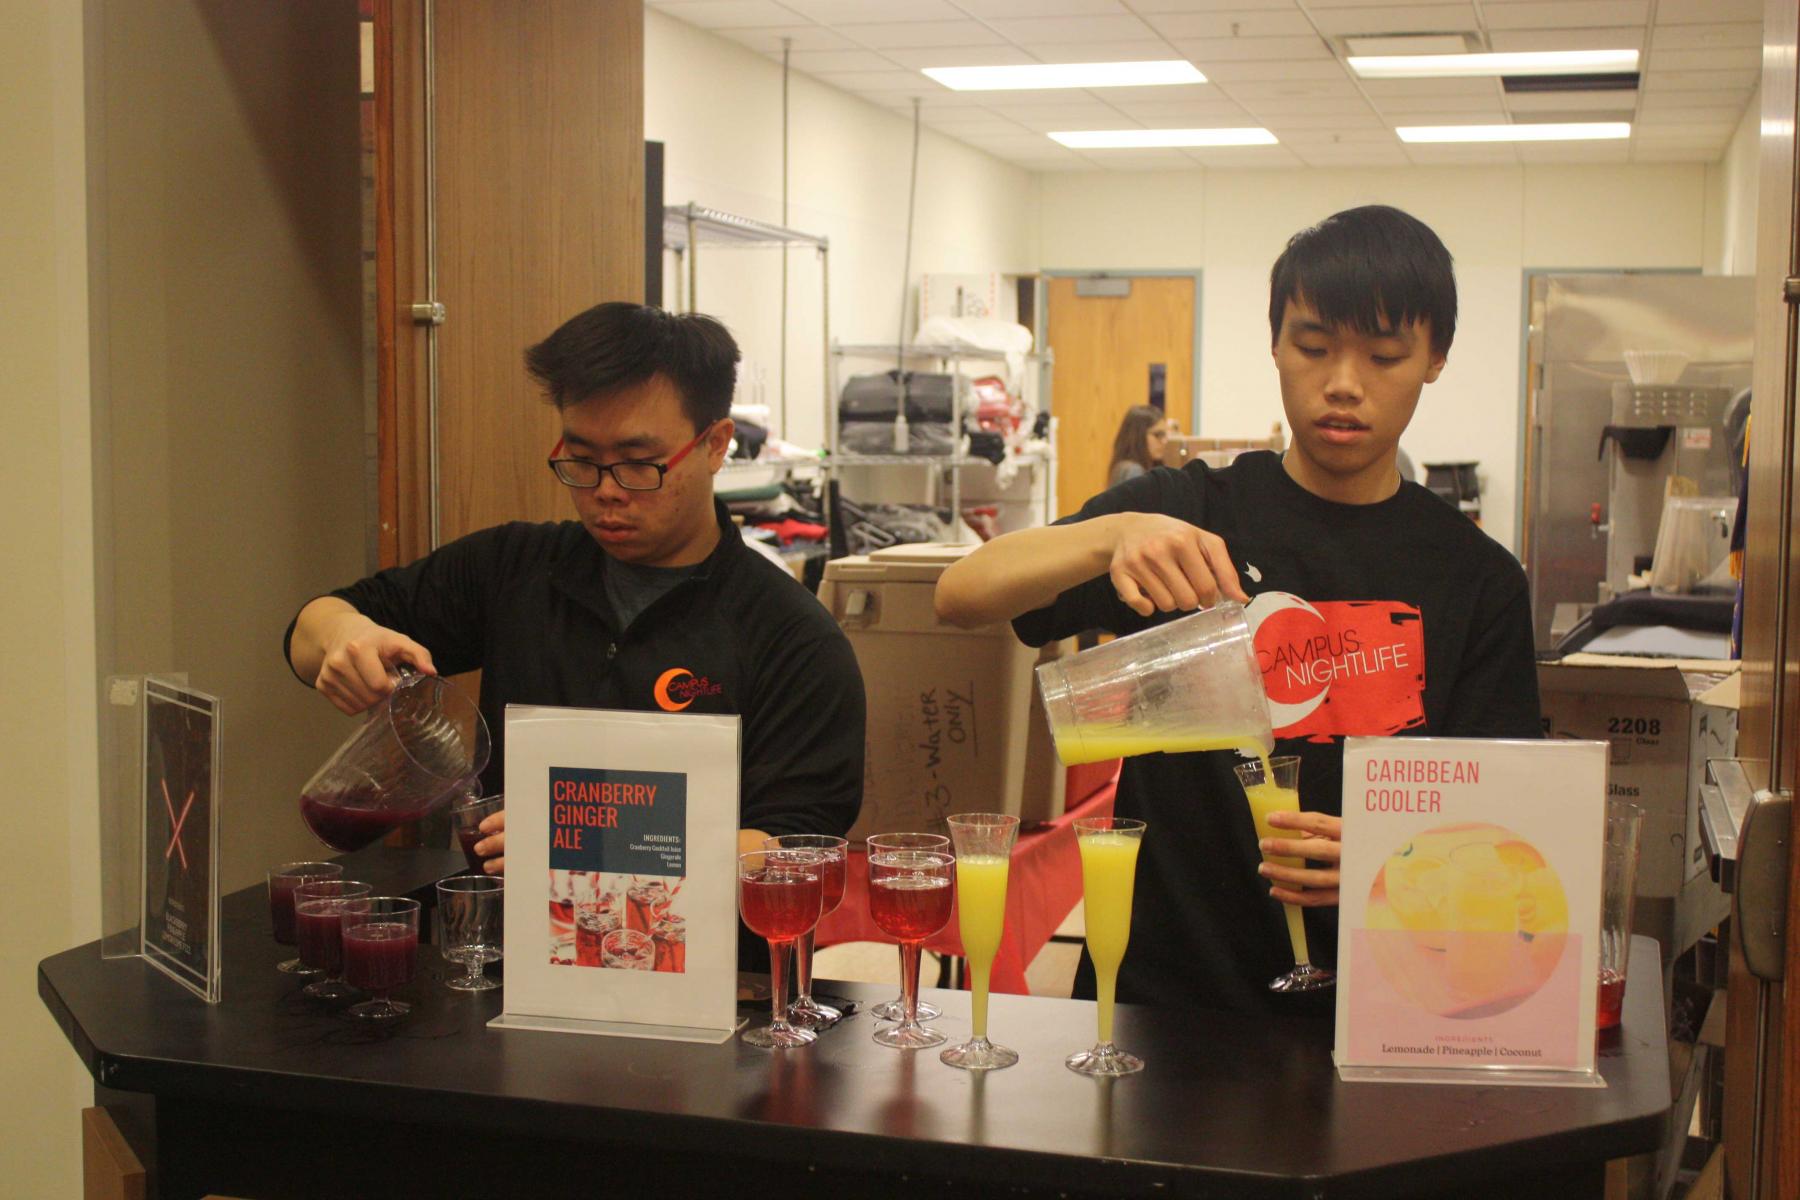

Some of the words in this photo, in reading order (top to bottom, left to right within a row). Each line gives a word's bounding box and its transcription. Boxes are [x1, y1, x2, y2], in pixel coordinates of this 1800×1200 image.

[1285, 643, 1409, 689] NIGHTLIFE
[668, 676, 709, 691] CAMPUS
[680, 682, 722, 698] NIGHTLIFE
[1607, 717, 1660, 735] 2208
[1366, 759, 1480, 784] CARIBBEAN
[553, 780, 657, 807] CRANBERRY
[1366, 789, 1442, 813] COOLER
[553, 804, 618, 829] GINGER
[553, 827, 583, 850] ALE
[629, 843, 651, 852] Cranberry
[651, 844, 670, 852] Cocktail
[1382, 1043, 1435, 1055] Lemonade
[1442, 1045, 1493, 1057] Pineapple
[1499, 1047, 1543, 1057] Coconut
